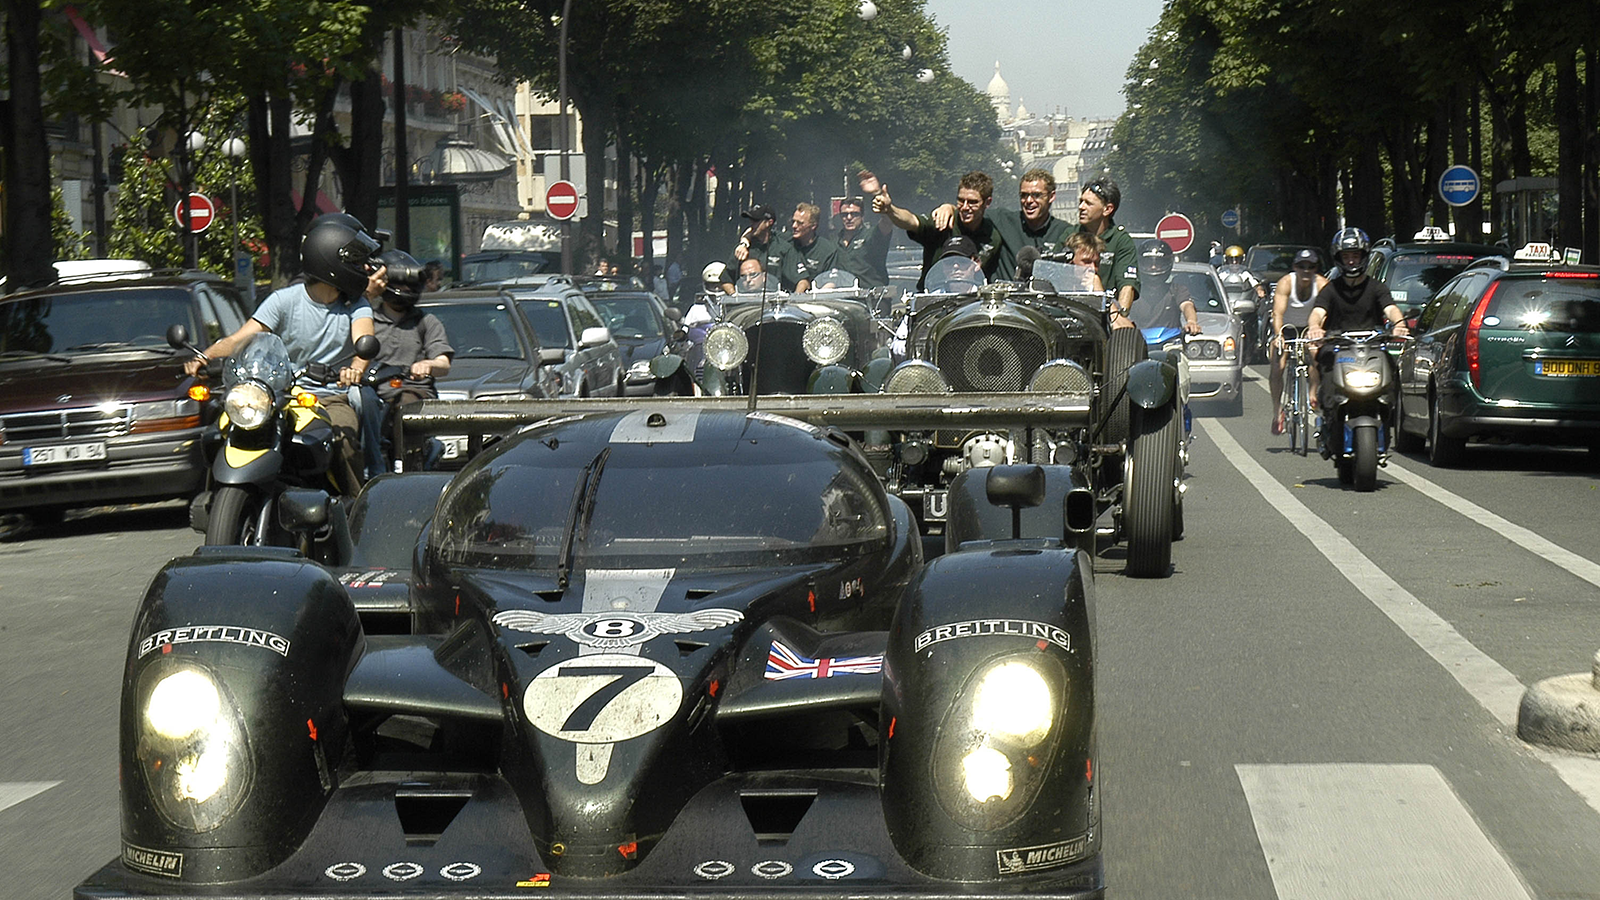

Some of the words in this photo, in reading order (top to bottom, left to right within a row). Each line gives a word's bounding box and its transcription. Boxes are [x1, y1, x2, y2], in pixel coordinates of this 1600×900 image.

[1529, 245, 1547, 254] TAXI
[1543, 361, 1565, 374] 900
[1567, 362, 1590, 374] DNH
[930, 494, 948, 518] U
[592, 618, 635, 638] B
[917, 621, 1068, 649] BREITLING
[141, 628, 286, 653] BREITLING
[557, 666, 656, 731] 7
[126, 847, 178, 870] MICHELIN
[1026, 840, 1085, 865] MICHELIN
